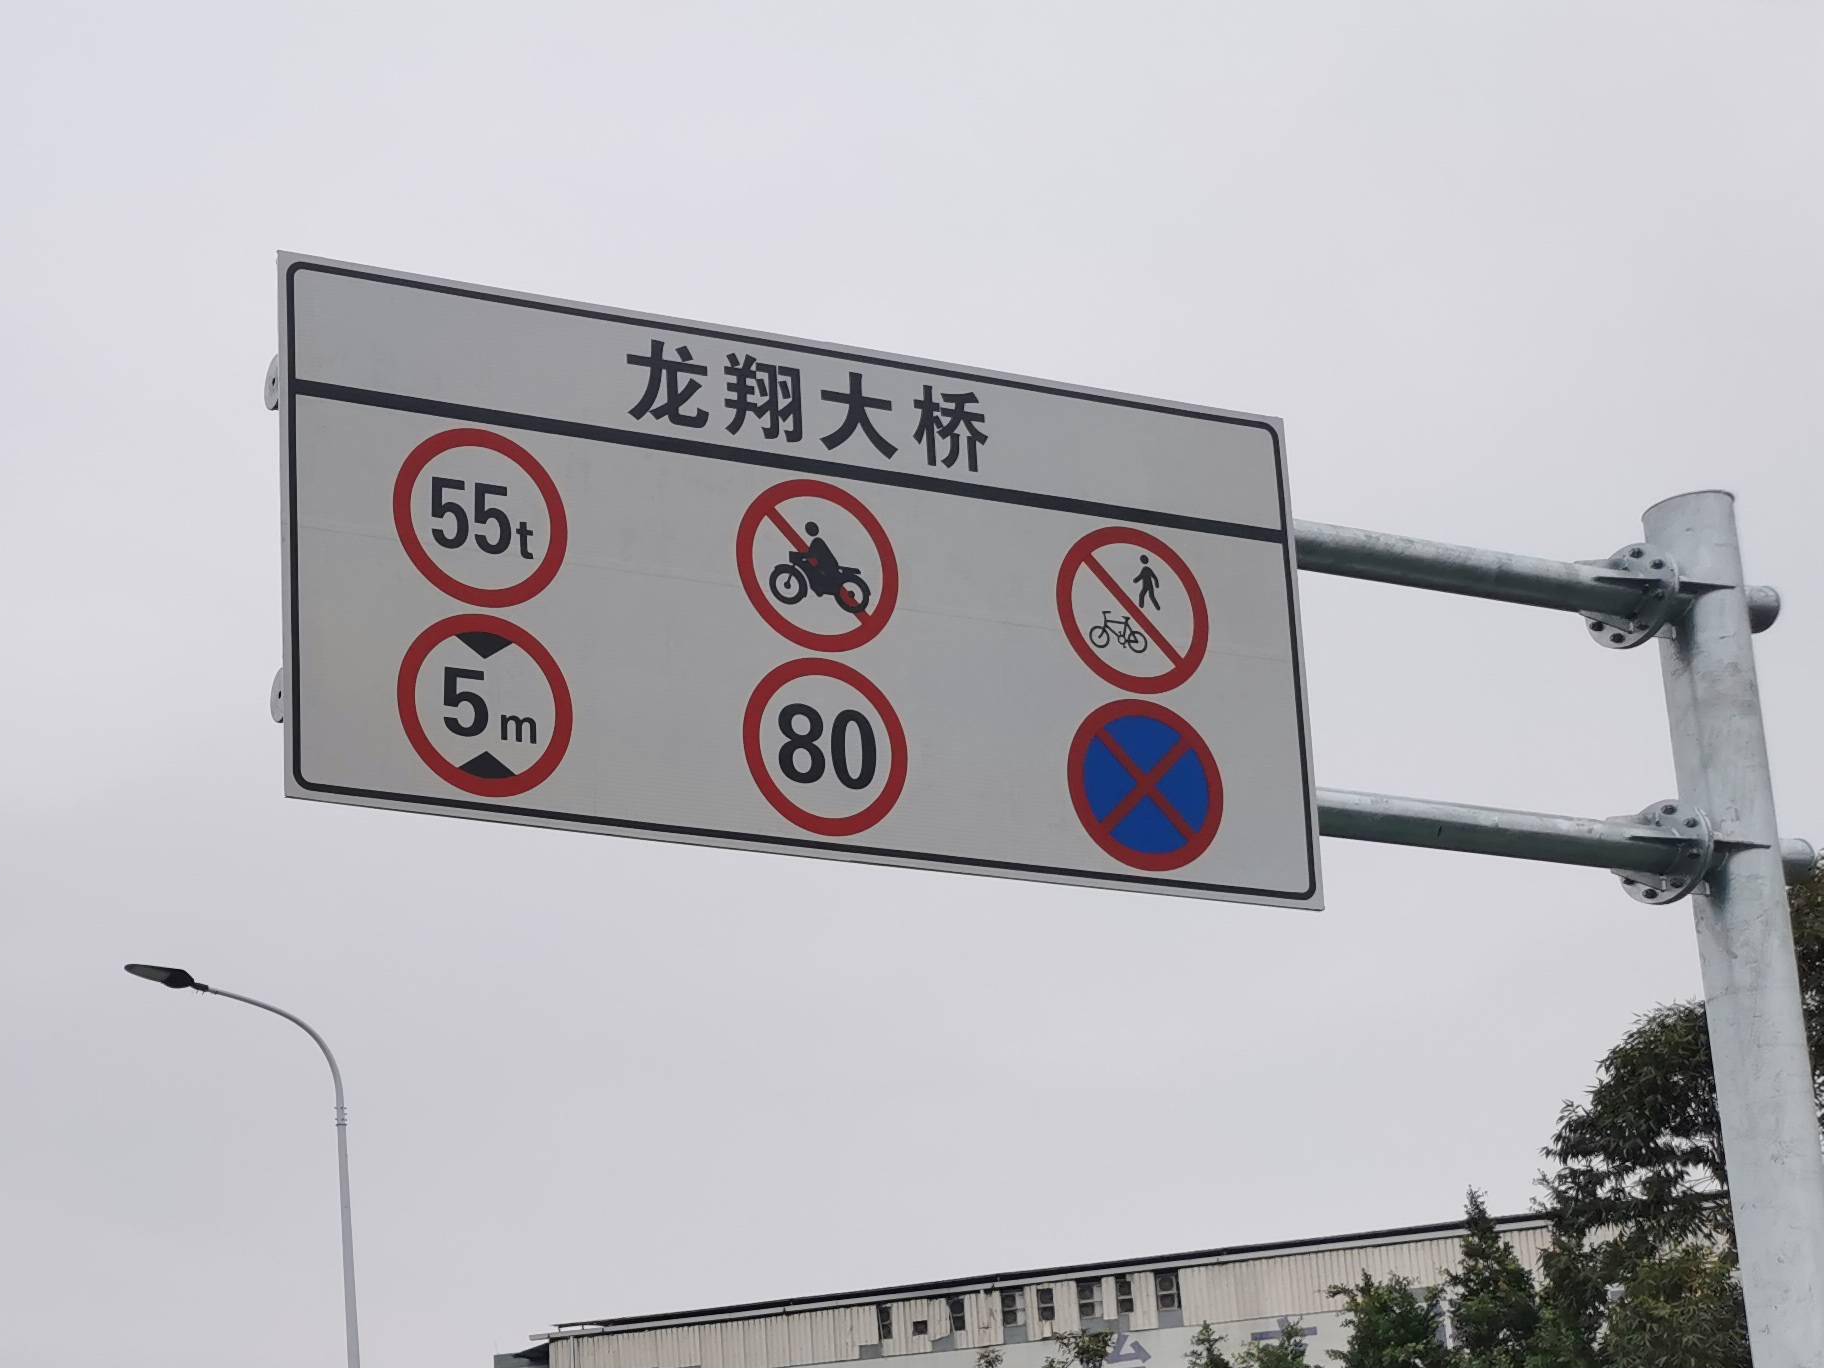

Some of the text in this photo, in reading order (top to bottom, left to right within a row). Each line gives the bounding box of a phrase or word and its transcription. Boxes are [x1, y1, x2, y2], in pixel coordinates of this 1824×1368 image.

[626, 338, 989, 474] 龙翔大桥
[430, 476, 535, 561] 55t
[777, 702, 878, 790] 80
